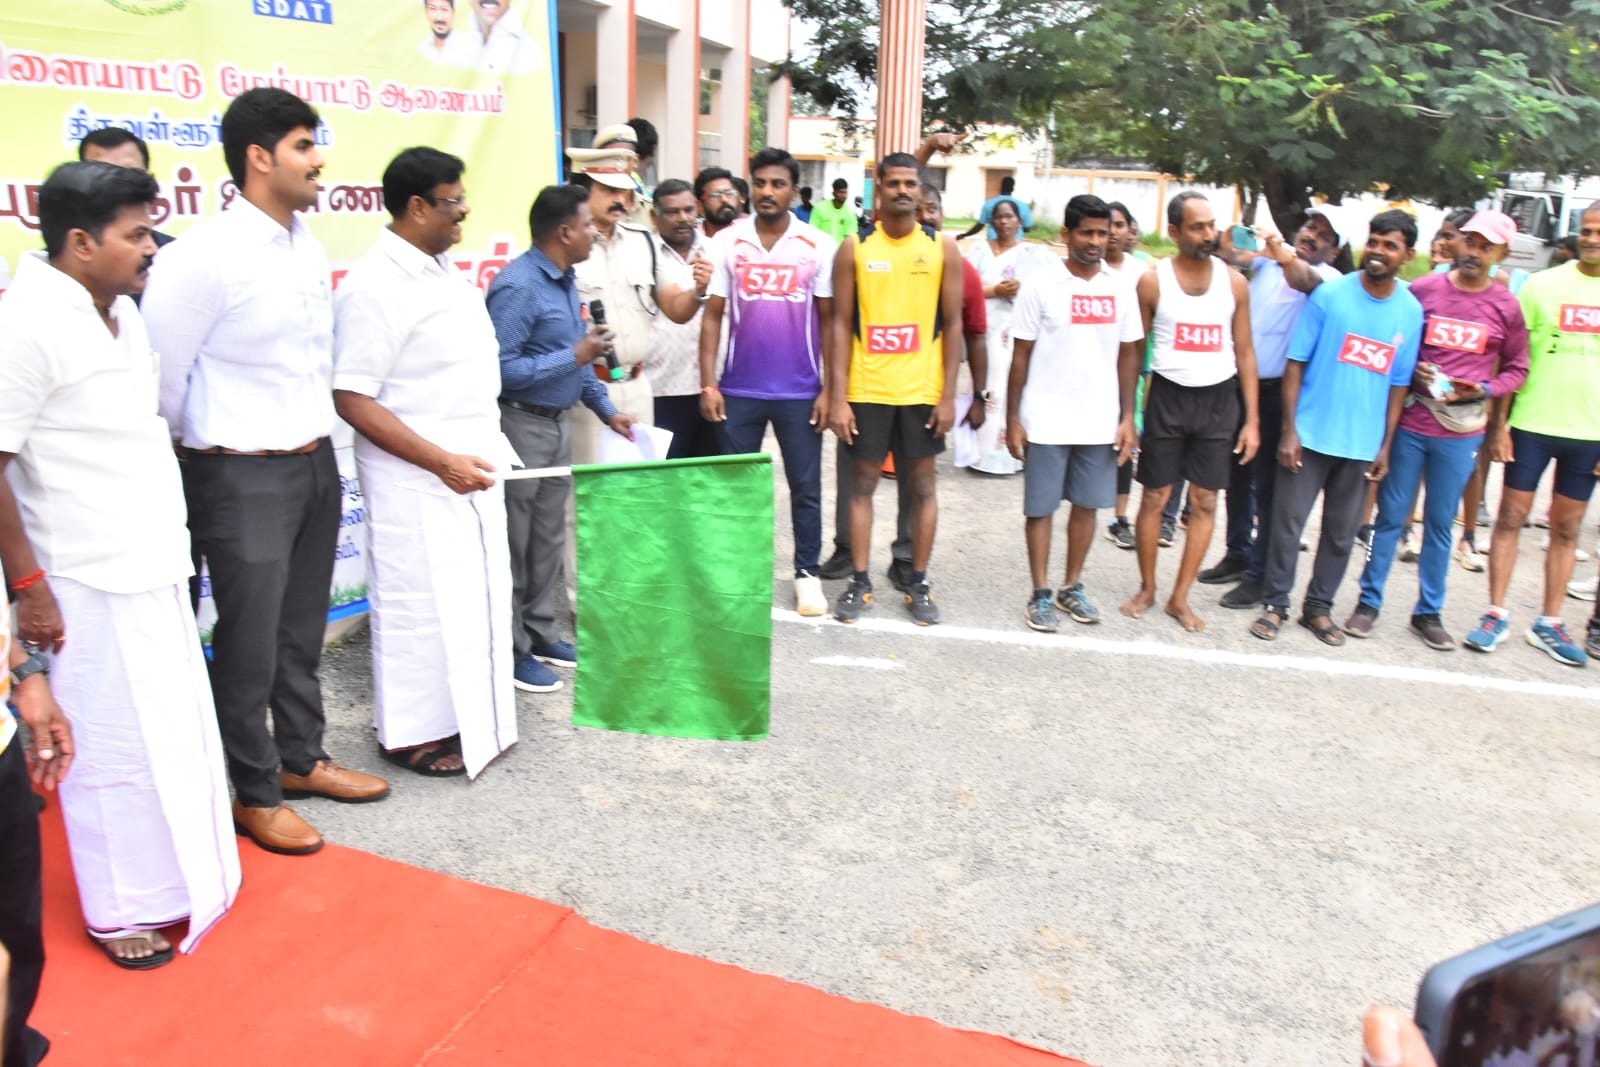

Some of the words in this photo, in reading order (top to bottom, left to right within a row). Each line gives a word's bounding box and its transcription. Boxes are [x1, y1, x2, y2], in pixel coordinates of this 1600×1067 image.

[256, 0, 325, 21] SDAT
[0, 51, 202, 99] ளையாட்டு
[380, 83, 504, 113] ஆணையம்
[747, 267, 794, 291] 527
[1071, 298, 1113, 317] 3303
[871, 327, 915, 350] 557
[1177, 326, 1220, 345] 3414
[1431, 322, 1480, 350] 532
[1343, 339, 1391, 369] 256
